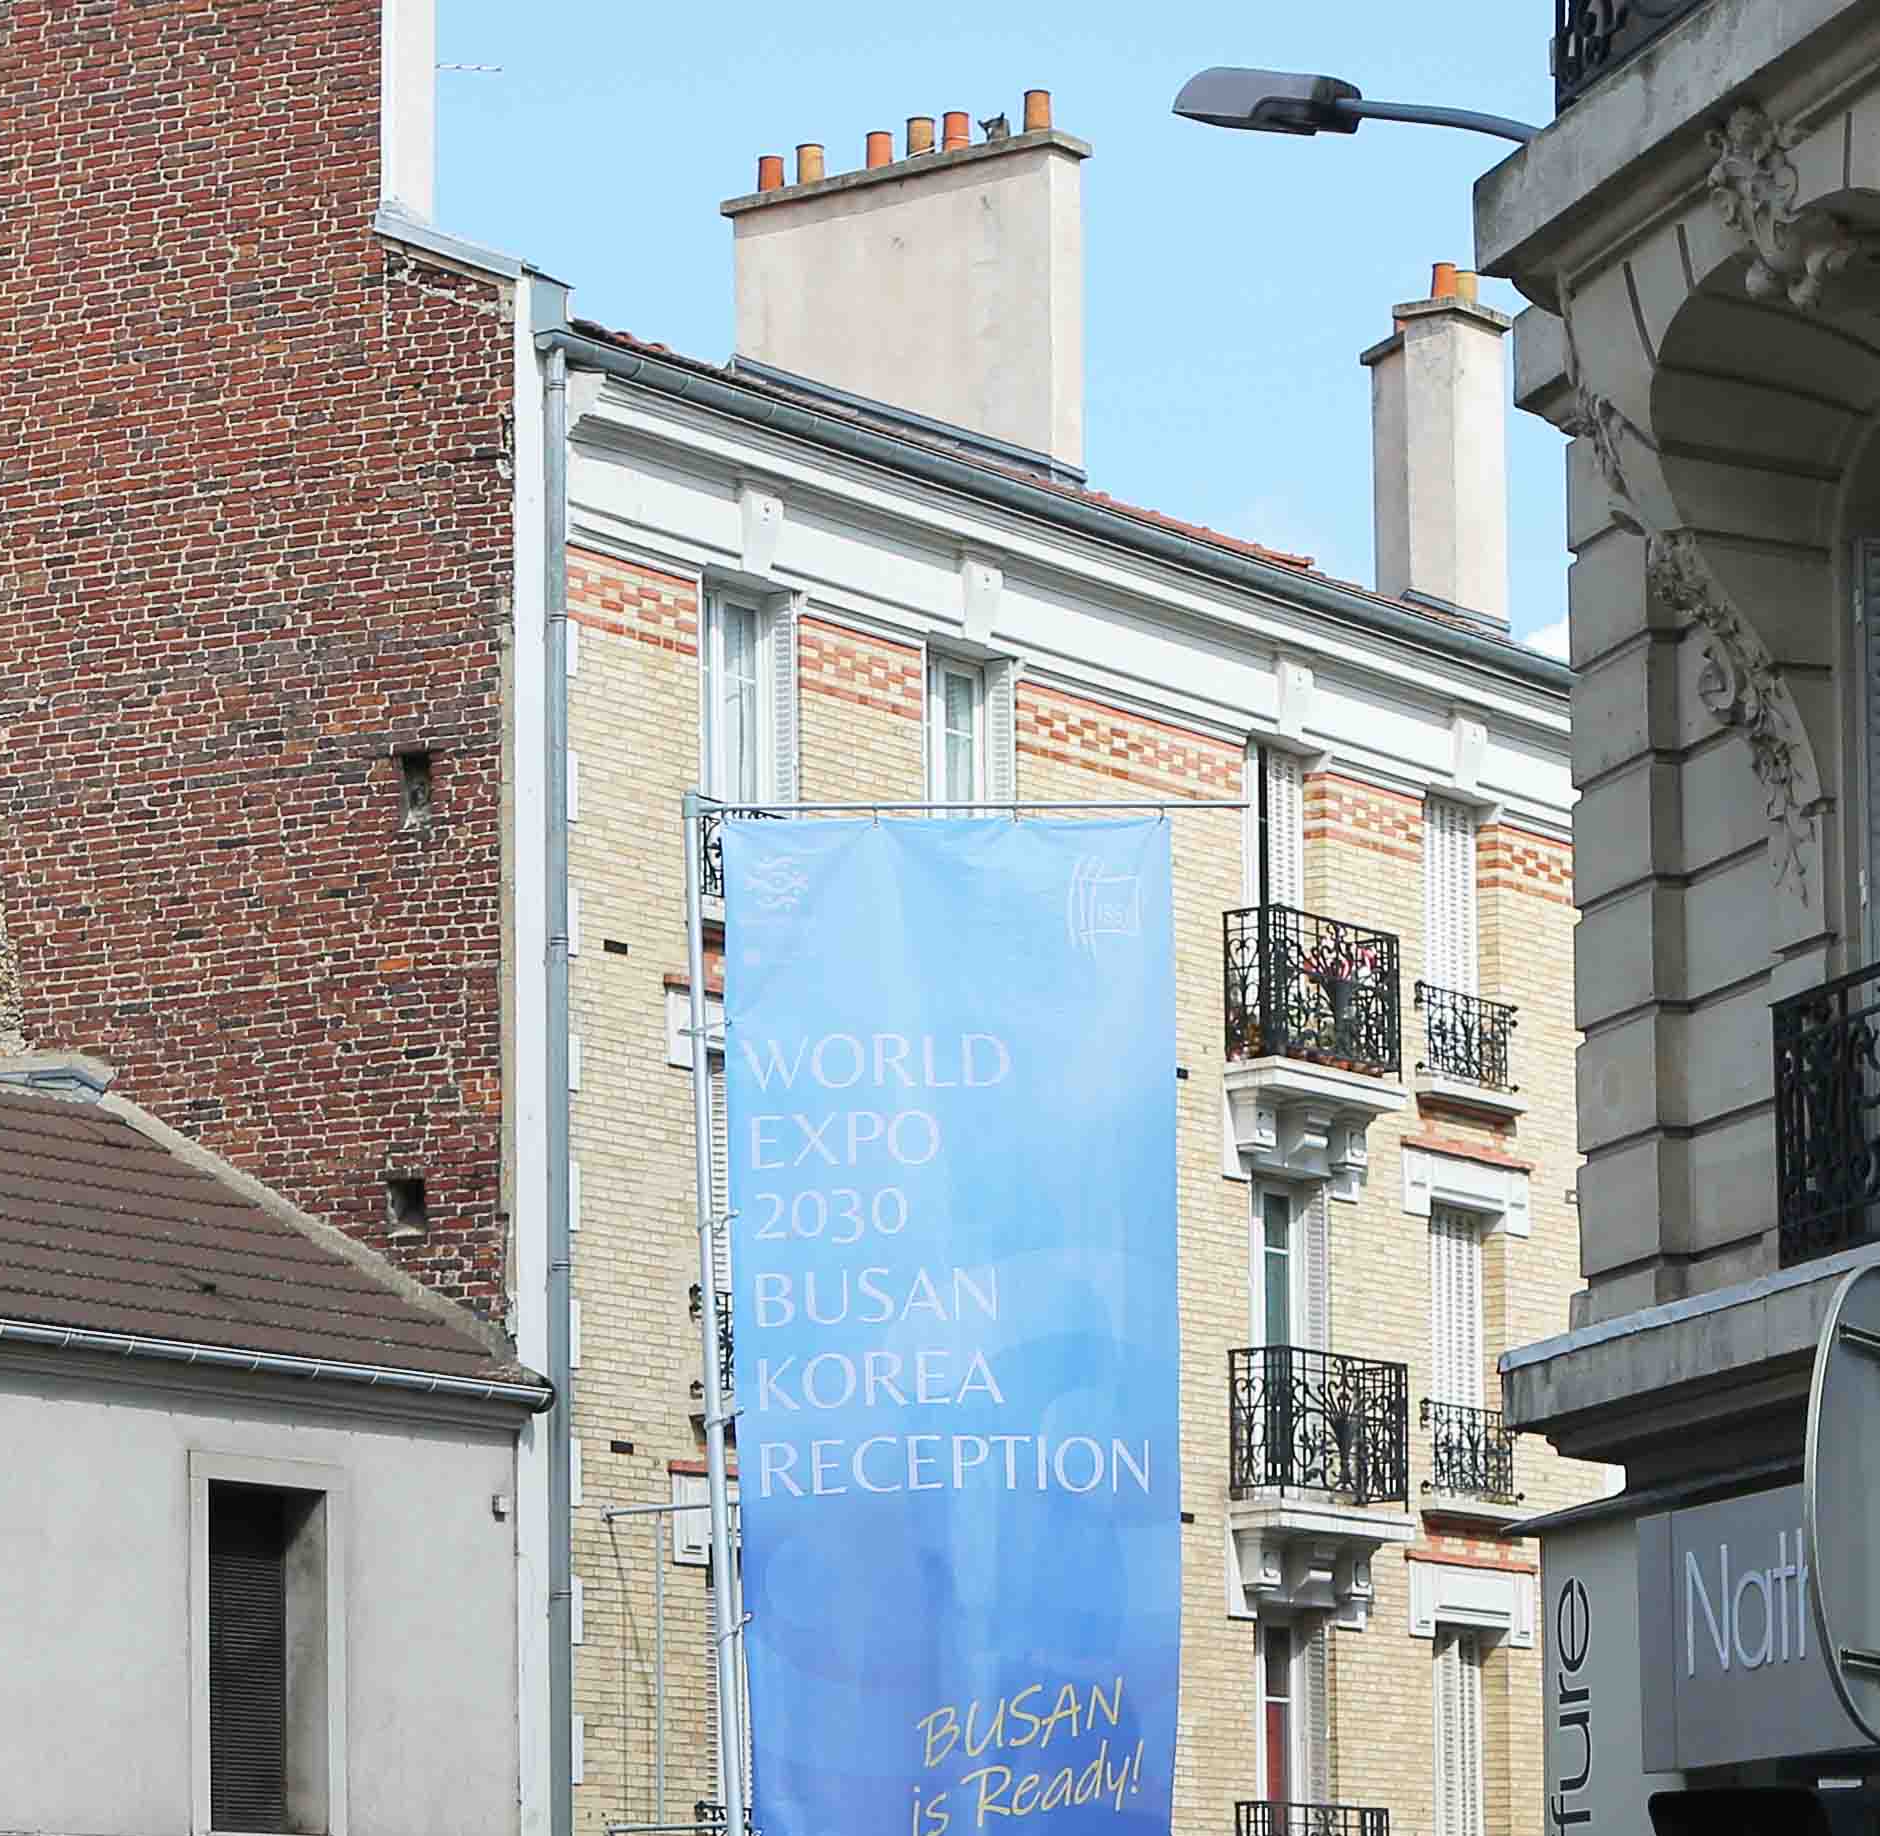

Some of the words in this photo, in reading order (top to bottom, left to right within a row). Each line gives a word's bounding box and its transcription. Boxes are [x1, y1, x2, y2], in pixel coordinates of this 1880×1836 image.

[744, 1033, 1011, 1092] WORLD
[751, 1109, 940, 1168] EXPO
[753, 1187, 908, 1244] 2030
[755, 1267, 999, 1329] BUSAN
[759, 1350, 1005, 1412] KOREA
[760, 1435, 1152, 1498] RECEPTION
[916, 1677, 1123, 1768] BUSAN
[960, 1739, 1144, 1827] Ready!
